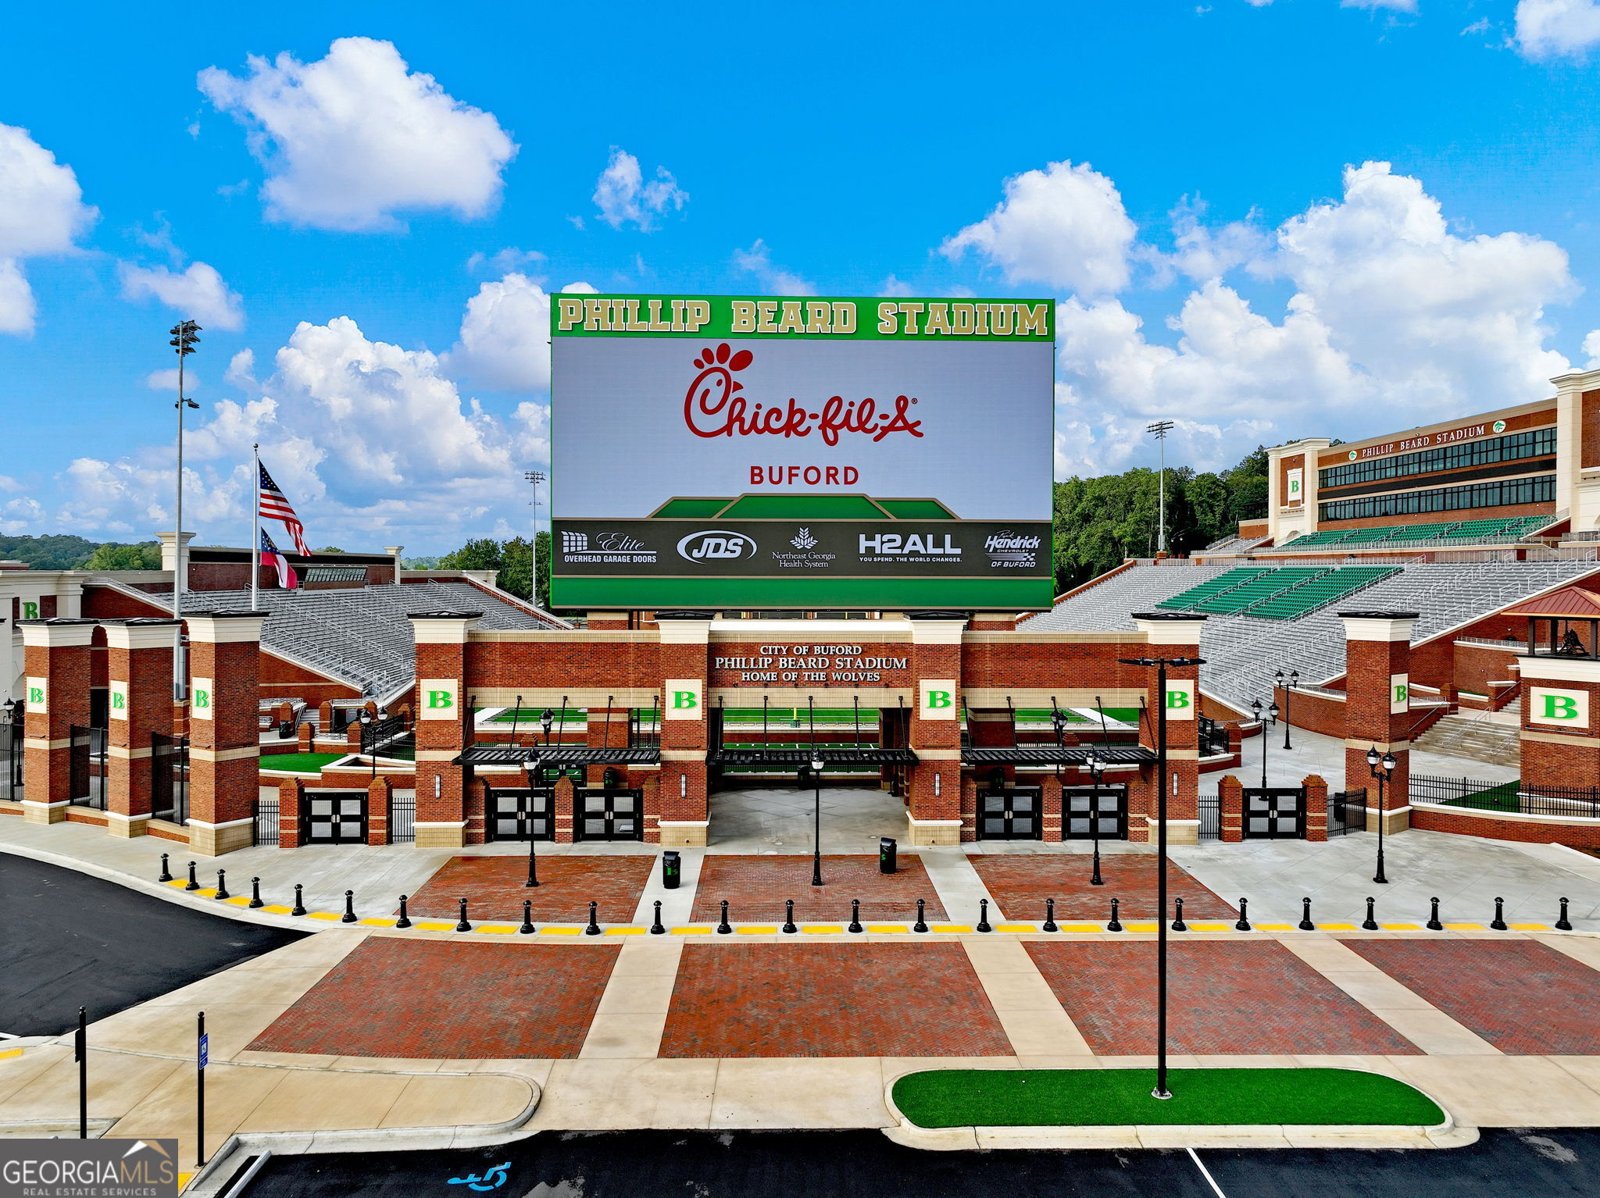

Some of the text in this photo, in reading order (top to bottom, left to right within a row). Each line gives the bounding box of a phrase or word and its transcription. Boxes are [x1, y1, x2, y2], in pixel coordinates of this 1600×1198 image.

[558, 298, 1048, 336] PHILLIP BEARD STADIUM
[684, 362, 925, 446] Chick-fil-A
[1362, 425, 1485, 458] PHILLIP BEARD STADIUM
[750, 465, 860, 486] BUFORD
[1290, 480, 1300, 494] B
[596, 532, 645, 551] Elite
[692, 538, 744, 558] JDS
[859, 534, 962, 554] H2ALL
[984, 536, 1041, 552] Hendrick
[564, 555, 601, 563] OVERHEAD
[804, 560, 829, 569] System
[808, 552, 836, 561] Georgia
[760, 645, 862, 655] CITY OF BUFORD
[715, 658, 907, 669] PHILLIP BEARD STADIUM
[742, 672, 880, 682] HOME OF THE WOLVES
[30, 687, 44, 703] B
[113, 692, 124, 710] B
[195, 690, 209, 708] B
[427, 690, 453, 709] B
[672, 690, 698, 709] B
[927, 690, 952, 709] B
[1393, 684, 1408, 703] B
[1540, 694, 1579, 720] B
